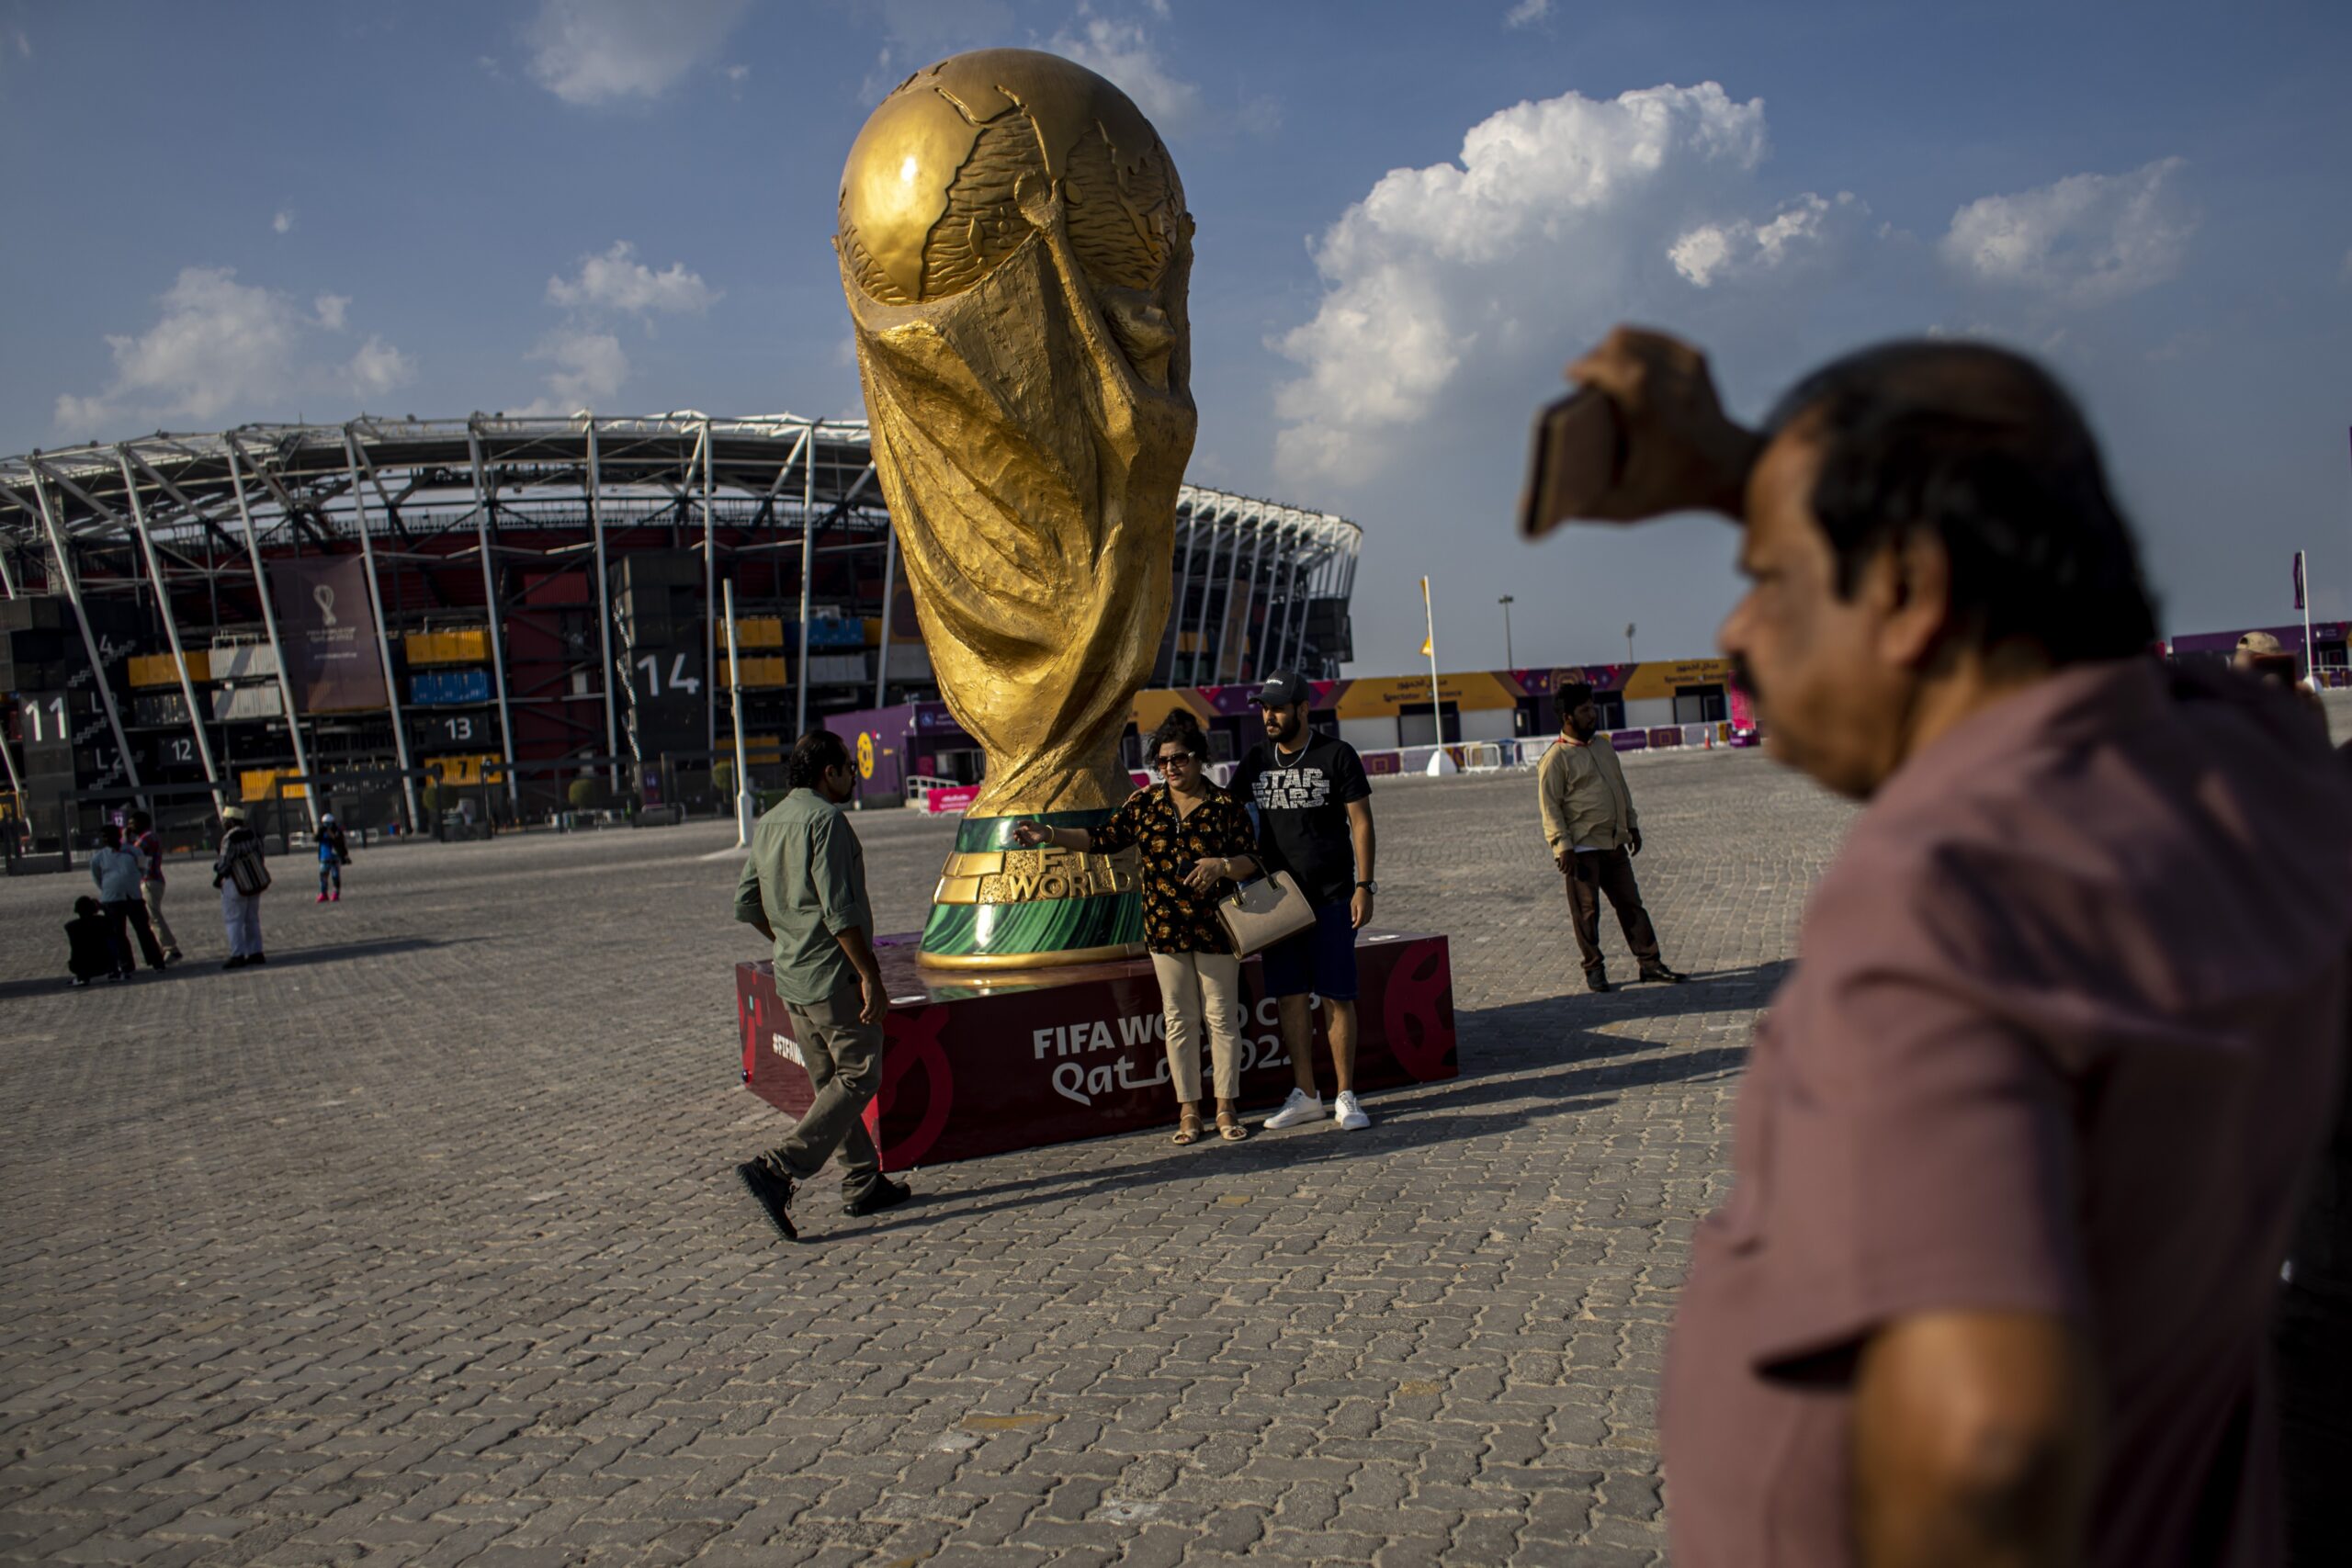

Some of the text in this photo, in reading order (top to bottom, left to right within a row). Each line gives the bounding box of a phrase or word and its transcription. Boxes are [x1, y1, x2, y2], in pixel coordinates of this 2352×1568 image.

[637, 652, 700, 697] 14
[25, 696, 67, 742] 11
[445, 716, 472, 740] 13
[171, 739, 192, 761] 12
[1251, 768, 1330, 789] STAR
[1252, 787, 1330, 809] WARS
[1009, 872, 1133, 900] WORLD
[1033, 1021, 1115, 1060] FIFA
